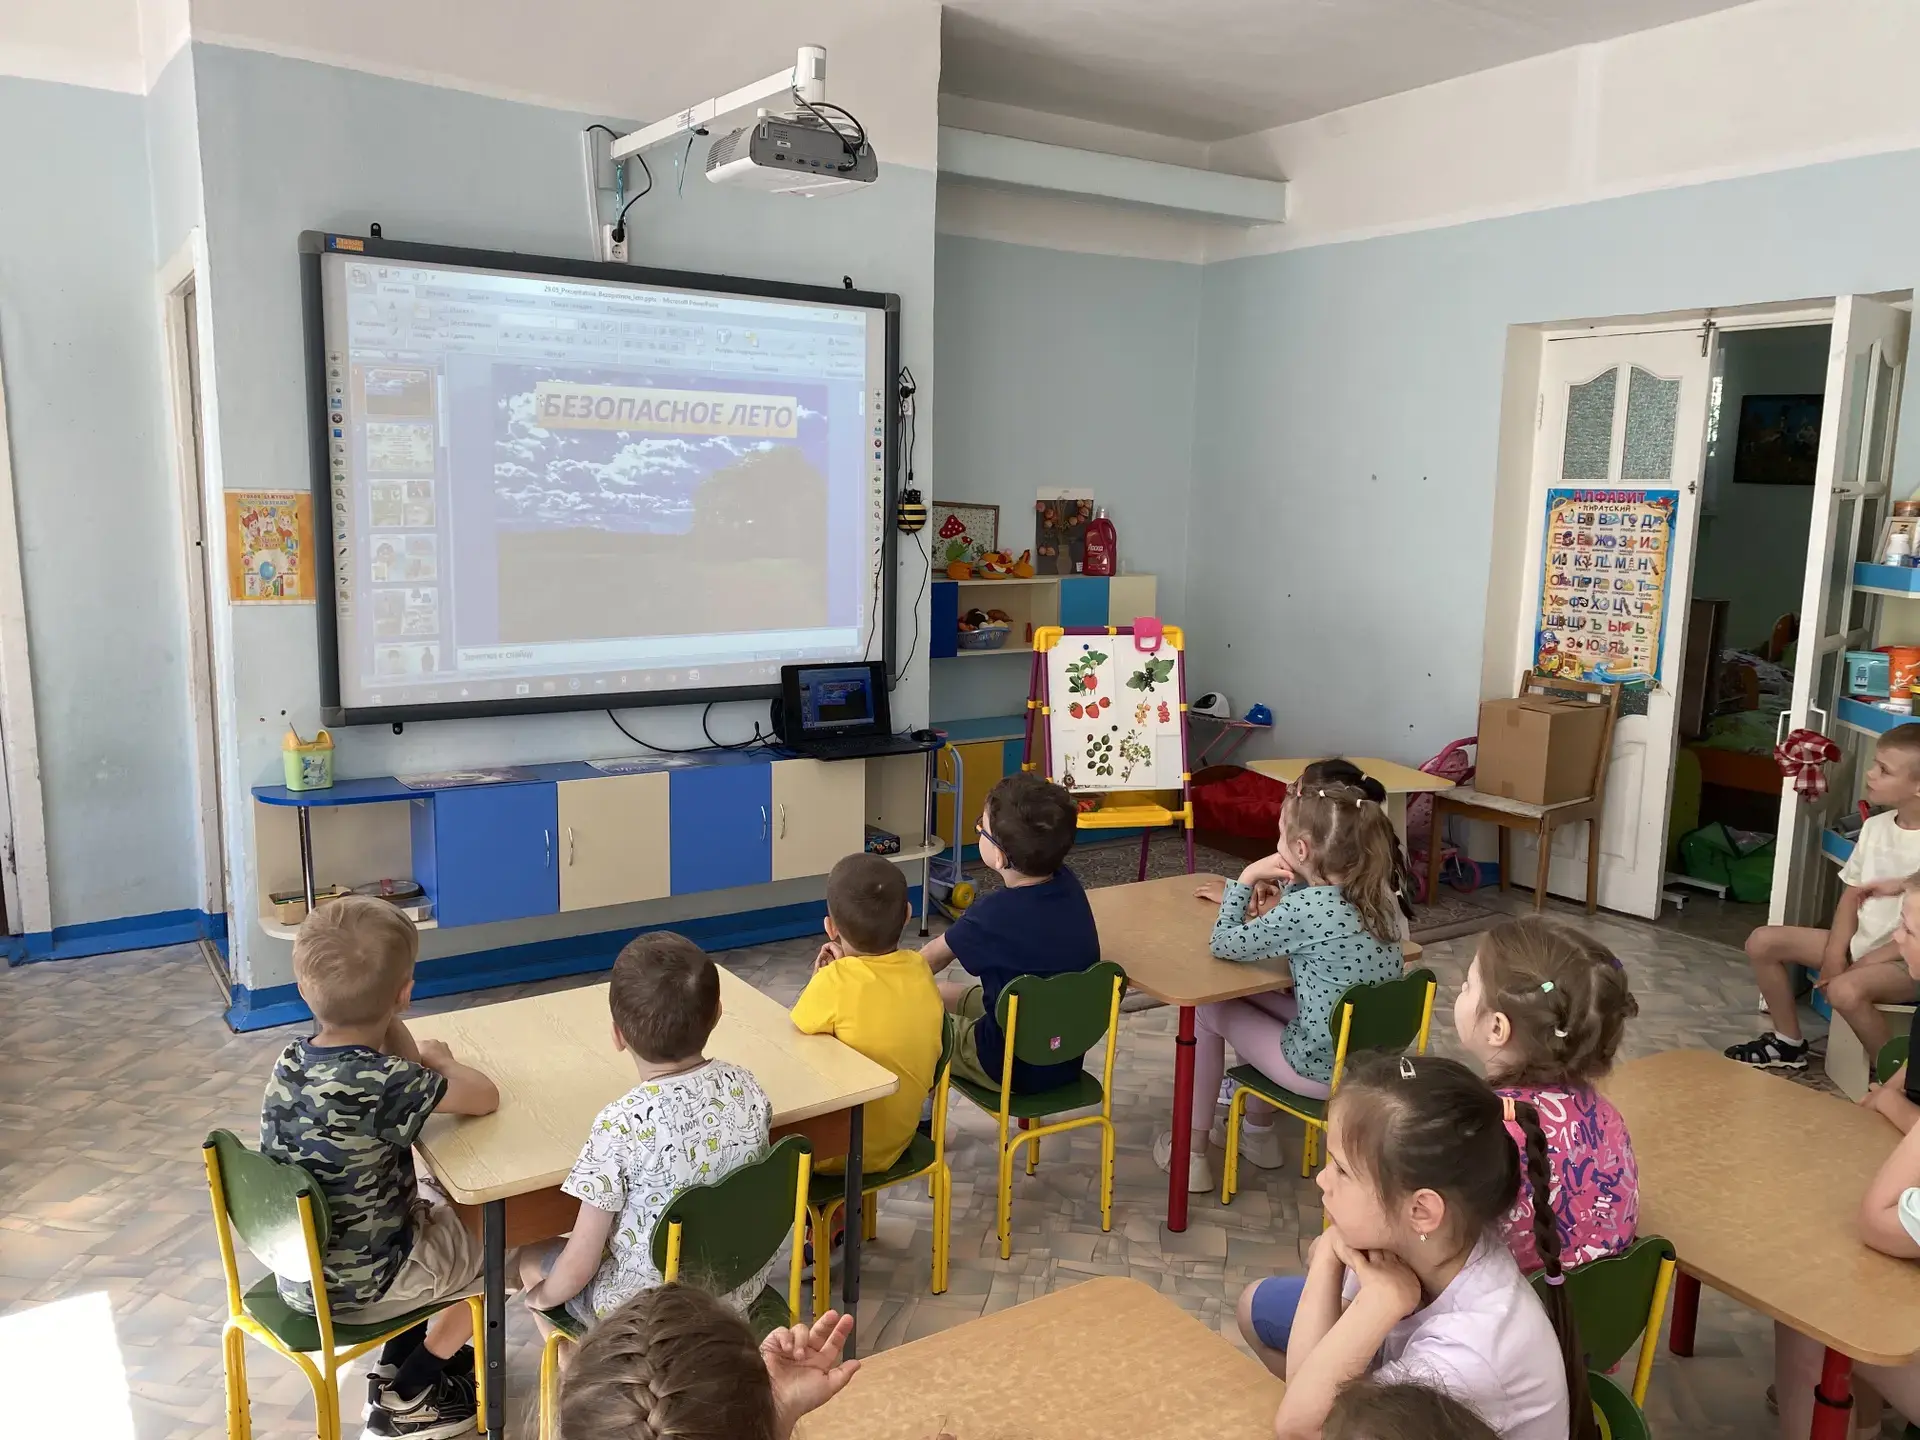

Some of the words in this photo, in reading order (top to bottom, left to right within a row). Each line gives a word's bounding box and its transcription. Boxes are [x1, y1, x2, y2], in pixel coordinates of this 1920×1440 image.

[543, 393, 724, 425] БЕЗОПАСНОЕ
[728, 404, 793, 428] ЛЕТО
[1574, 490, 1647, 503] АЛФАВИТ
[1583, 504, 1631, 512] ПИРАТСКИЙ
[1556, 512, 1564, 523] А
[1578, 513, 1586, 524] Б
[1599, 513, 1608, 525] В
[1621, 514, 1629, 525] Г
[1641, 514, 1652, 528] Д
[1554, 533, 1562, 544] Е
[1577, 531, 1585, 545] Ё
[1595, 534, 1607, 546] Ж
[1619, 536, 1627, 547] З
[1640, 536, 1650, 548] И
[1574, 555, 1582, 566] К
[1594, 556, 1604, 567] Л
[1615, 557, 1626, 568] М
[1638, 558, 1648, 570] Н
[1550, 575, 1559, 585] О
[1572, 576, 1580, 587] П
[1593, 578, 1601, 588] Р
[1614, 579, 1623, 590] С
[1637, 580, 1646, 592] Т
[1550, 594, 1558, 606] У
[1569, 597, 1579, 608] Ф
[1591, 598, 1600, 610] Х
[1613, 598, 1623, 613] Ц
[1635, 602, 1643, 613] Ч
[1547, 615, 1559, 626] Ш
[1568, 616, 1580, 630] Щ
[1591, 618, 1602, 630] Ъ
[1608, 620, 1621, 632] Ы
[1635, 622, 1645, 634] Ь
[1567, 637, 1575, 648] Э
[1586, 639, 1600, 651] Ю
[1609, 641, 1618, 653] Я
